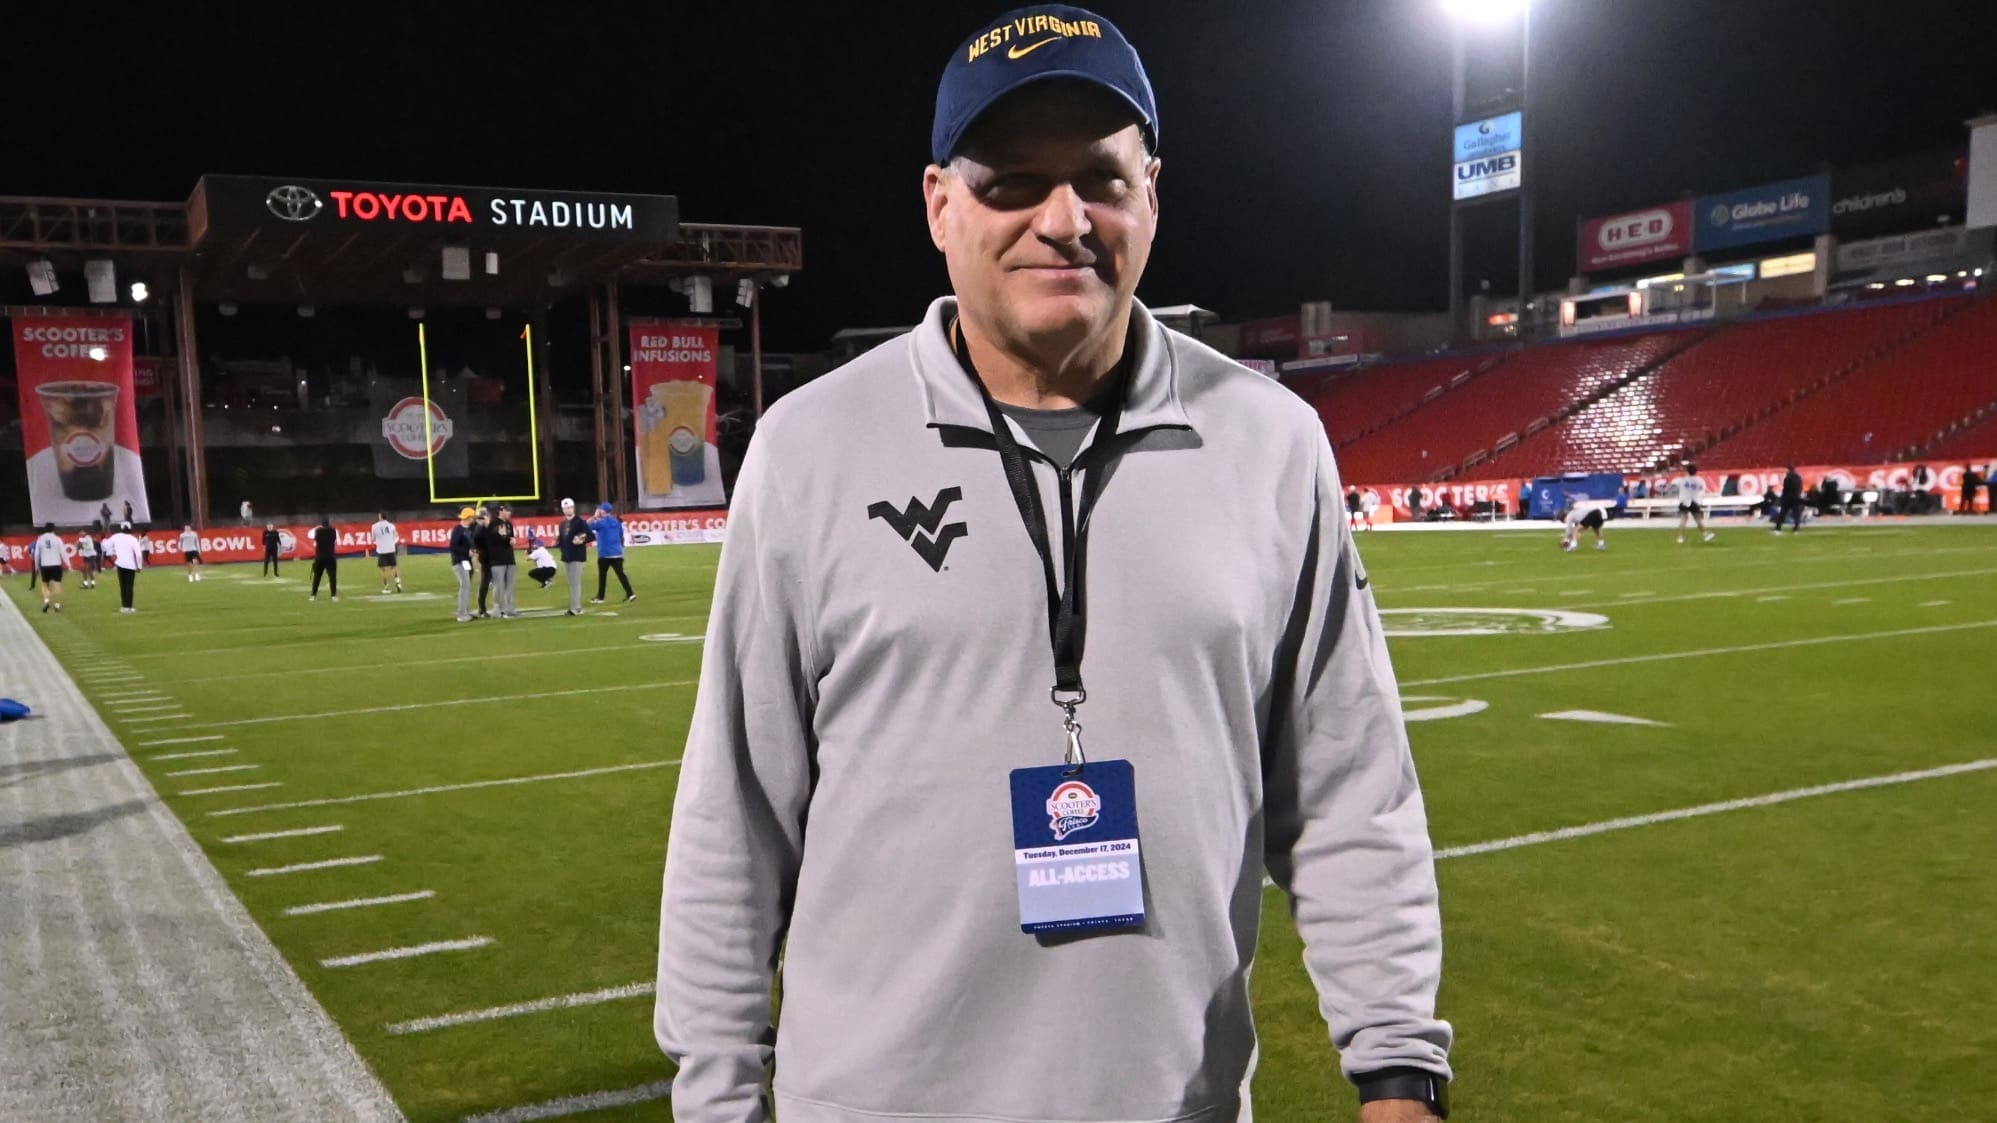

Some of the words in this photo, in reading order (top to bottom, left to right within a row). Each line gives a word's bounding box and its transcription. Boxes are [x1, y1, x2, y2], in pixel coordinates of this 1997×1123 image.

[968, 24, 1012, 63] WEST
[1014, 14, 1102, 39] VIRGINIA
[1457, 155, 1516, 180] UMB
[329, 191, 473, 224] TOYOTA
[490, 198, 634, 230] STADIUM
[1731, 200, 1777, 220] Globe
[1780, 192, 1810, 212] Life
[23, 327, 125, 342] SCOOTER'S
[641, 335, 668, 348] RED
[672, 335, 704, 349] BULL
[633, 349, 712, 362] INFUSIONS
[200, 536, 256, 552] BOWL
[1059, 845, 1098, 857] December
[1110, 842, 1132, 852] 2024
[1028, 860, 1131, 888] ALL-ACCESS
